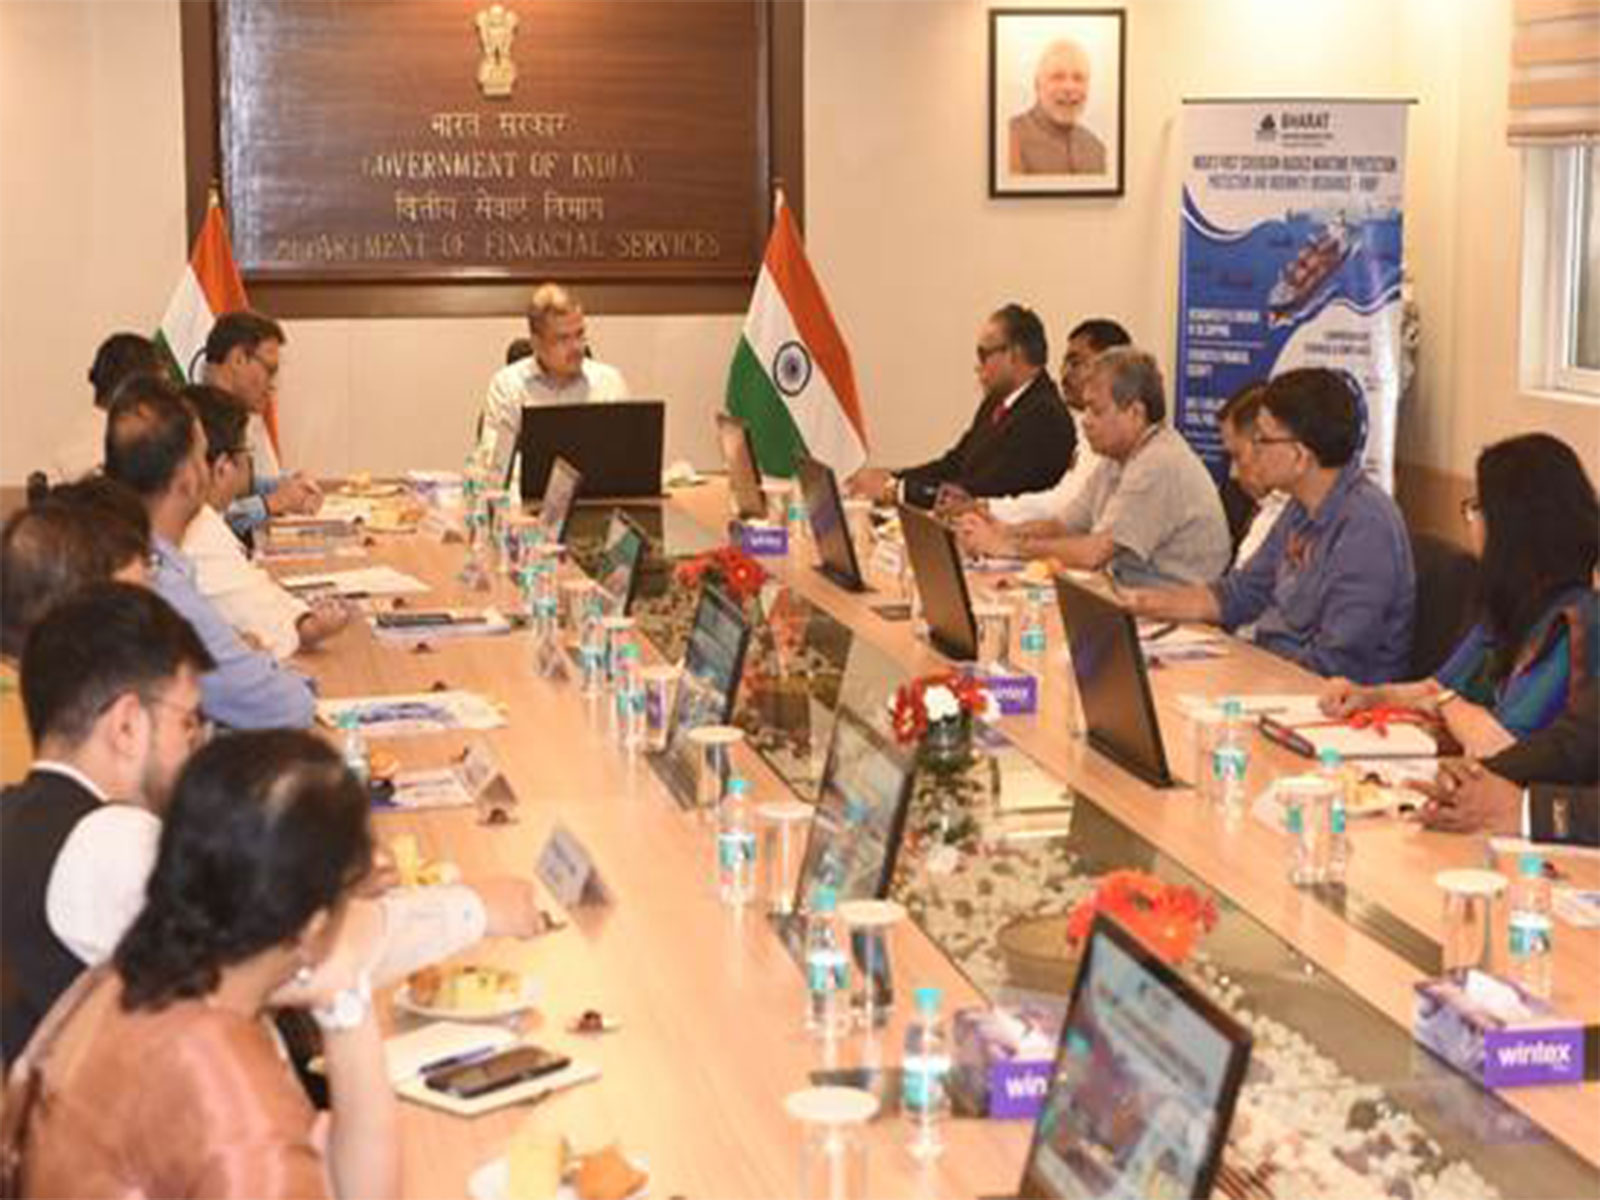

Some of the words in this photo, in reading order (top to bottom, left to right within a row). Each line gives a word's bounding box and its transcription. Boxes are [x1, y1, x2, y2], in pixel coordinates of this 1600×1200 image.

[431, 112, 480, 137] भारत
[361, 152, 518, 178] GOVERNMENT
[528, 152, 558, 178] OF
[572, 152, 636, 178] INDIA
[617, 230, 721, 260] SERVICES
[1497, 1040, 1572, 1067] wintex
[1004, 1071, 1048, 1098] win
